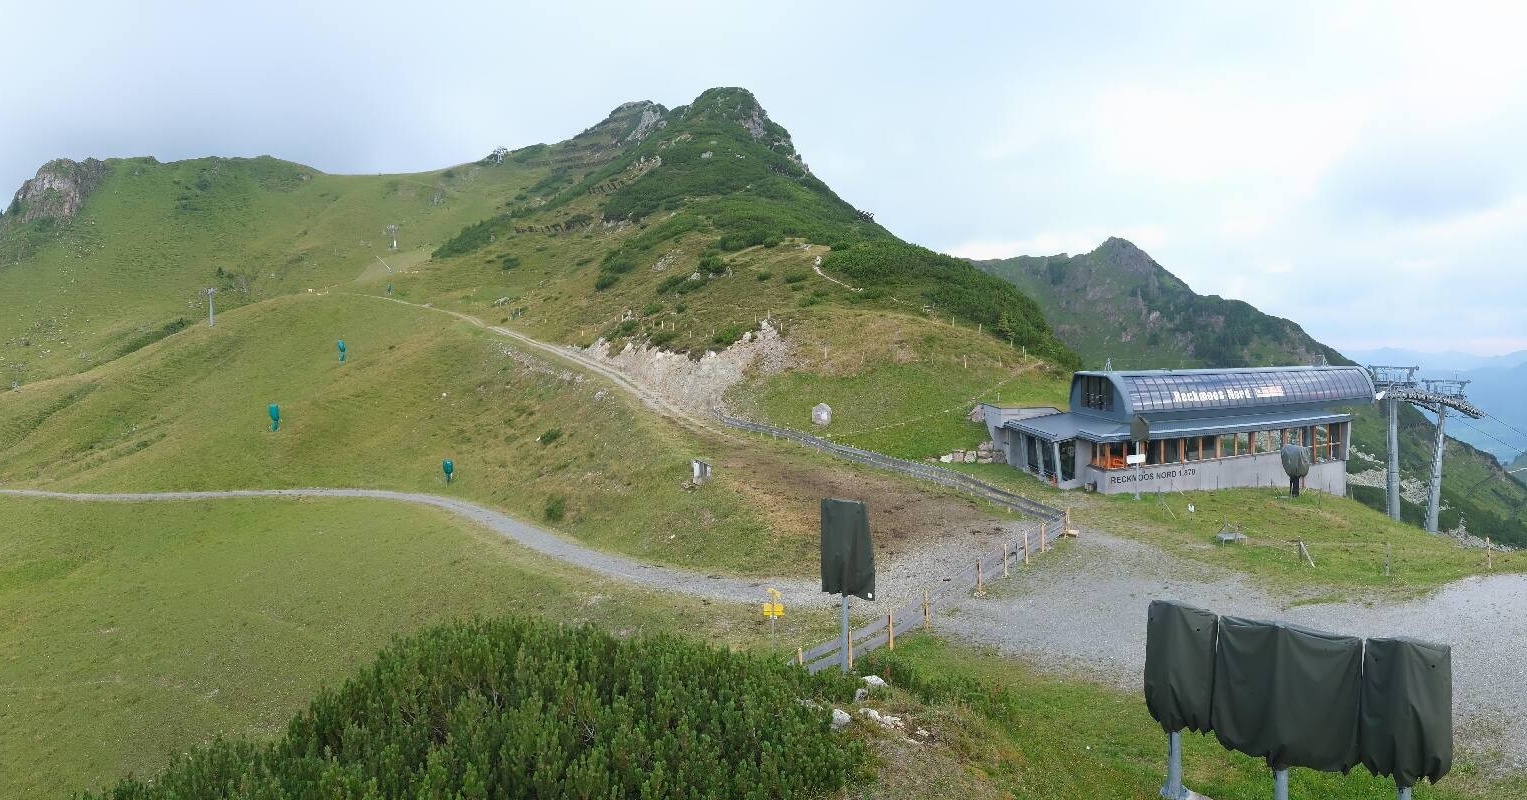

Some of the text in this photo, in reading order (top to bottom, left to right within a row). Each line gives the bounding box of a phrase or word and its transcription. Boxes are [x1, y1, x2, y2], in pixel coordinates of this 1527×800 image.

[1173, 390, 1225, 402] Reckmoos
[1227, 386, 1252, 400] Nord
[1157, 470, 1177, 480] NORD
